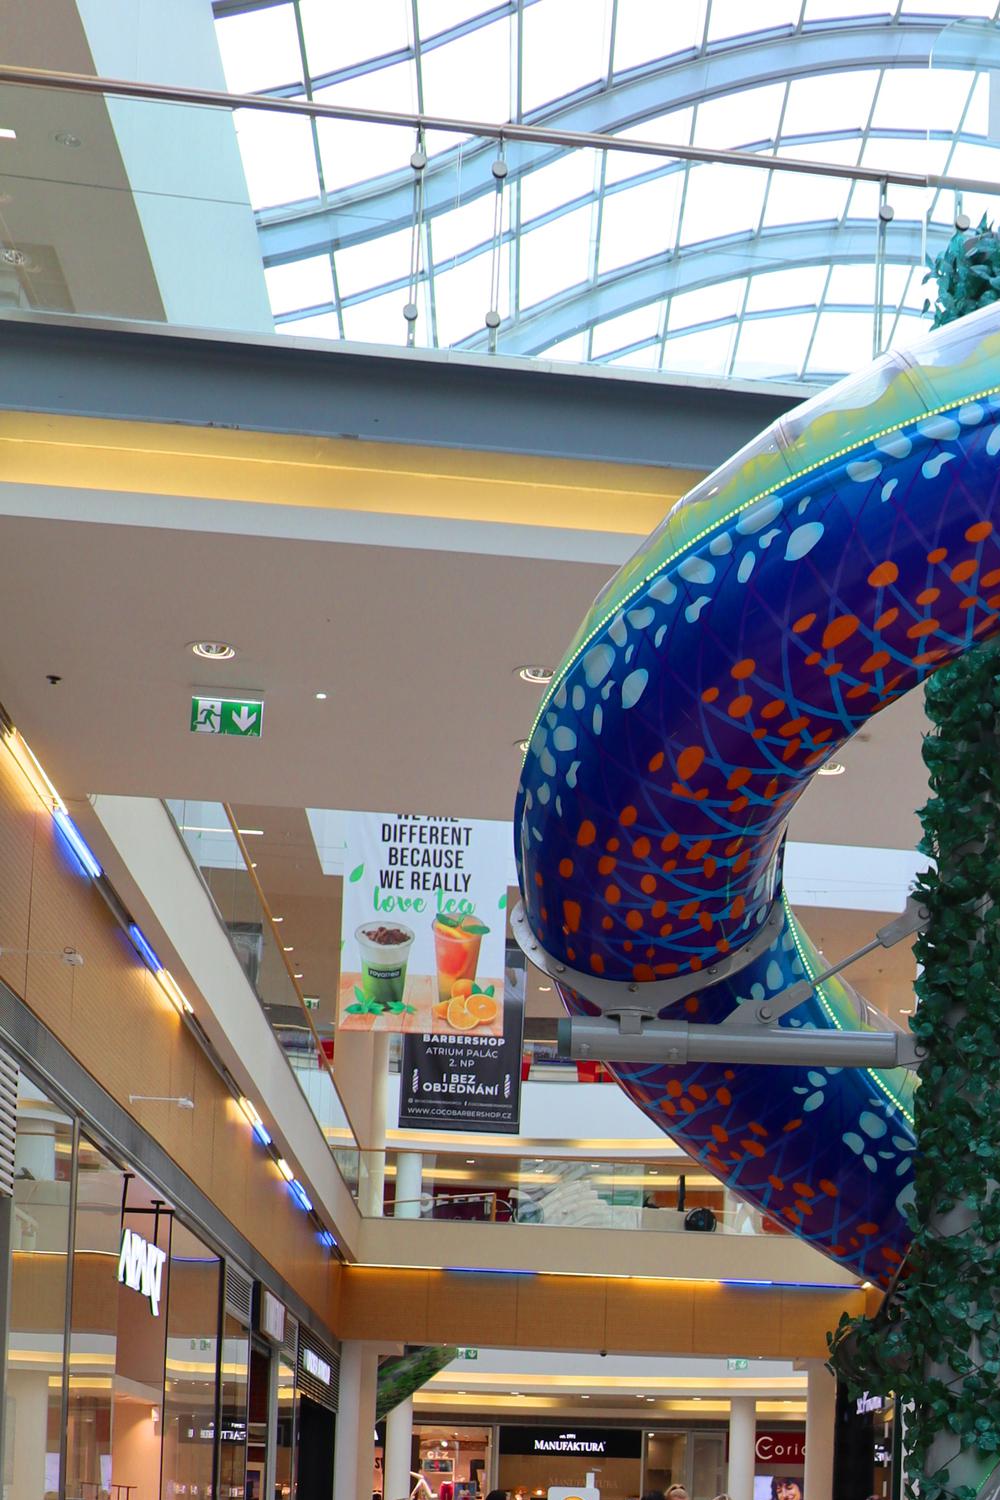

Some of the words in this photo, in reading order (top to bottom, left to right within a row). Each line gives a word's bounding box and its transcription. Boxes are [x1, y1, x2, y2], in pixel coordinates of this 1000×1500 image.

[382, 823, 473, 846] DIFFERENT
[389, 847, 464, 869] BECAUSE
[380, 870, 405, 889] WE
[410, 871, 472, 892] REALLY
[373, 886, 426, 913] love
[434, 887, 476, 916] tea
[423, 1034, 505, 1046] BARBERSHOP
[426, 1047, 464, 1056] ATRIUM
[466, 1048, 498, 1059] PALÁC
[449, 1059, 457, 1067] 2.
[451, 1074, 476, 1084] BEZ
[423, 1082, 499, 1096] OBJEDNÁNÍ
[408, 1107, 512, 1119] WWW.COCOBARBERSHOP.CZ
[534, 1440, 605, 1452] MANUFAKTURA
